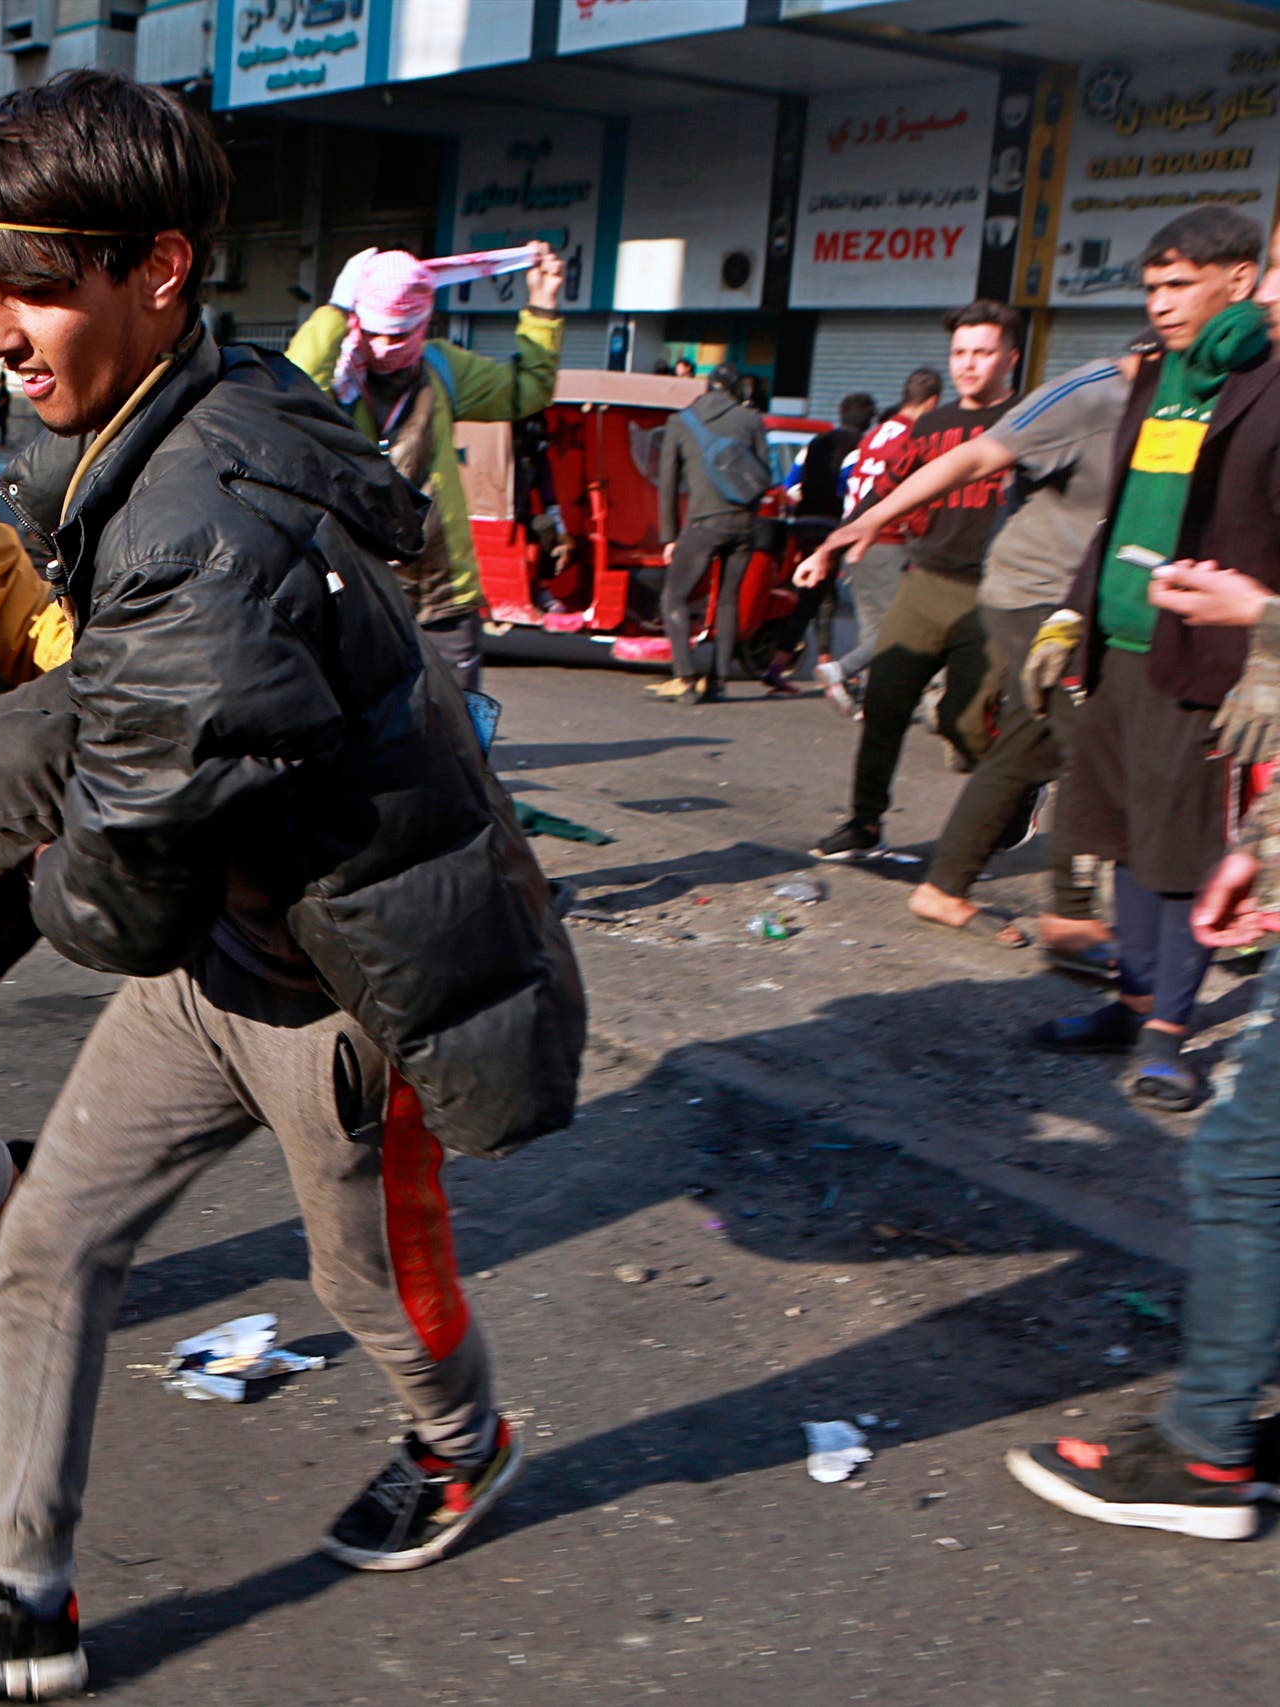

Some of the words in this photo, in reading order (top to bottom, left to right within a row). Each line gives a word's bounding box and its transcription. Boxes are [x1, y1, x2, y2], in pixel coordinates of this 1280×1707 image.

[1087, 154, 1143, 179] CAM
[1148, 146, 1254, 175] GOLDEN
[813, 225, 966, 263] MEZORY
